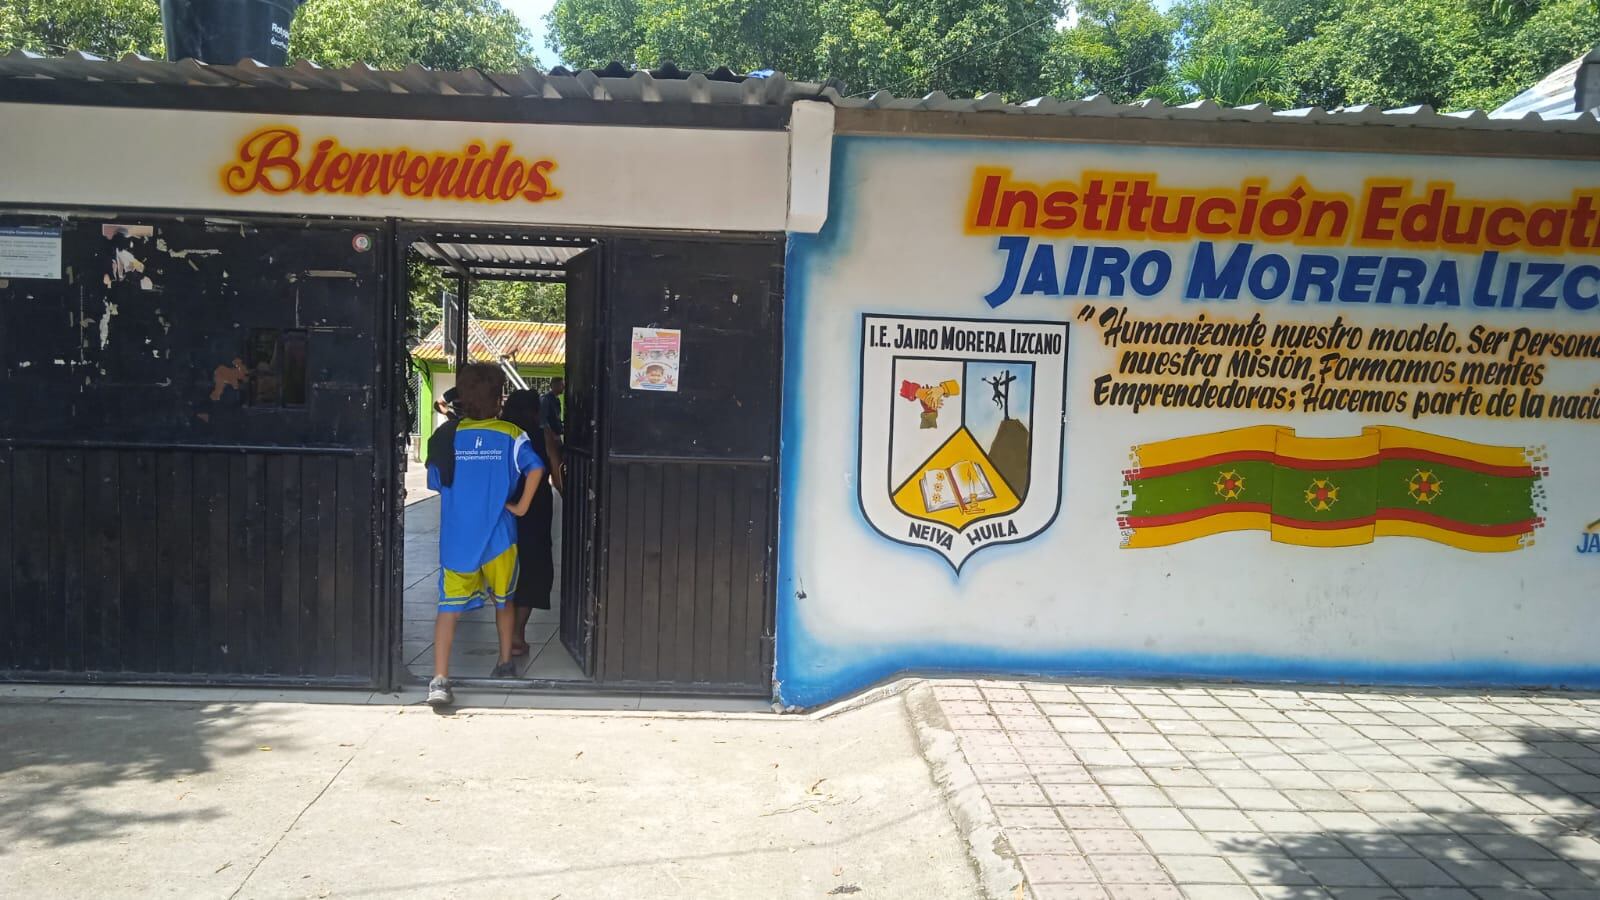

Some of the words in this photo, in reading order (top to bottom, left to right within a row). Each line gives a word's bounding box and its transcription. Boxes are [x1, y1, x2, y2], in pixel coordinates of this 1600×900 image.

[225, 128, 557, 203] Bienvenidos
[974, 175, 1349, 238] Institución
[984, 236, 1173, 309] JAIRO
[1185, 241, 1461, 307] MORERA
[869, 325, 891, 348] I.E.
[894, 324, 938, 350] JAIRO
[941, 326, 1007, 353] MORERA
[1009, 328, 1062, 355] LIZCANO
[1271, 316, 1363, 350] nuestro
[1368, 322, 1462, 353] modelo.
[1467, 325, 1509, 355] Ser
[1119, 346, 1222, 376] nuestra
[1319, 352, 1456, 384] Formamos
[1460, 356, 1545, 386] mentes
[1093, 374, 1297, 414] Emprendedoras;
[1301, 382, 1408, 414] Hacemos
[1412, 386, 1486, 419] parte
[1486, 388, 1517, 417] de
[1519, 388, 1545, 418] la
[908, 522, 954, 551] NEIVA
[965, 520, 1019, 545] HUILA
